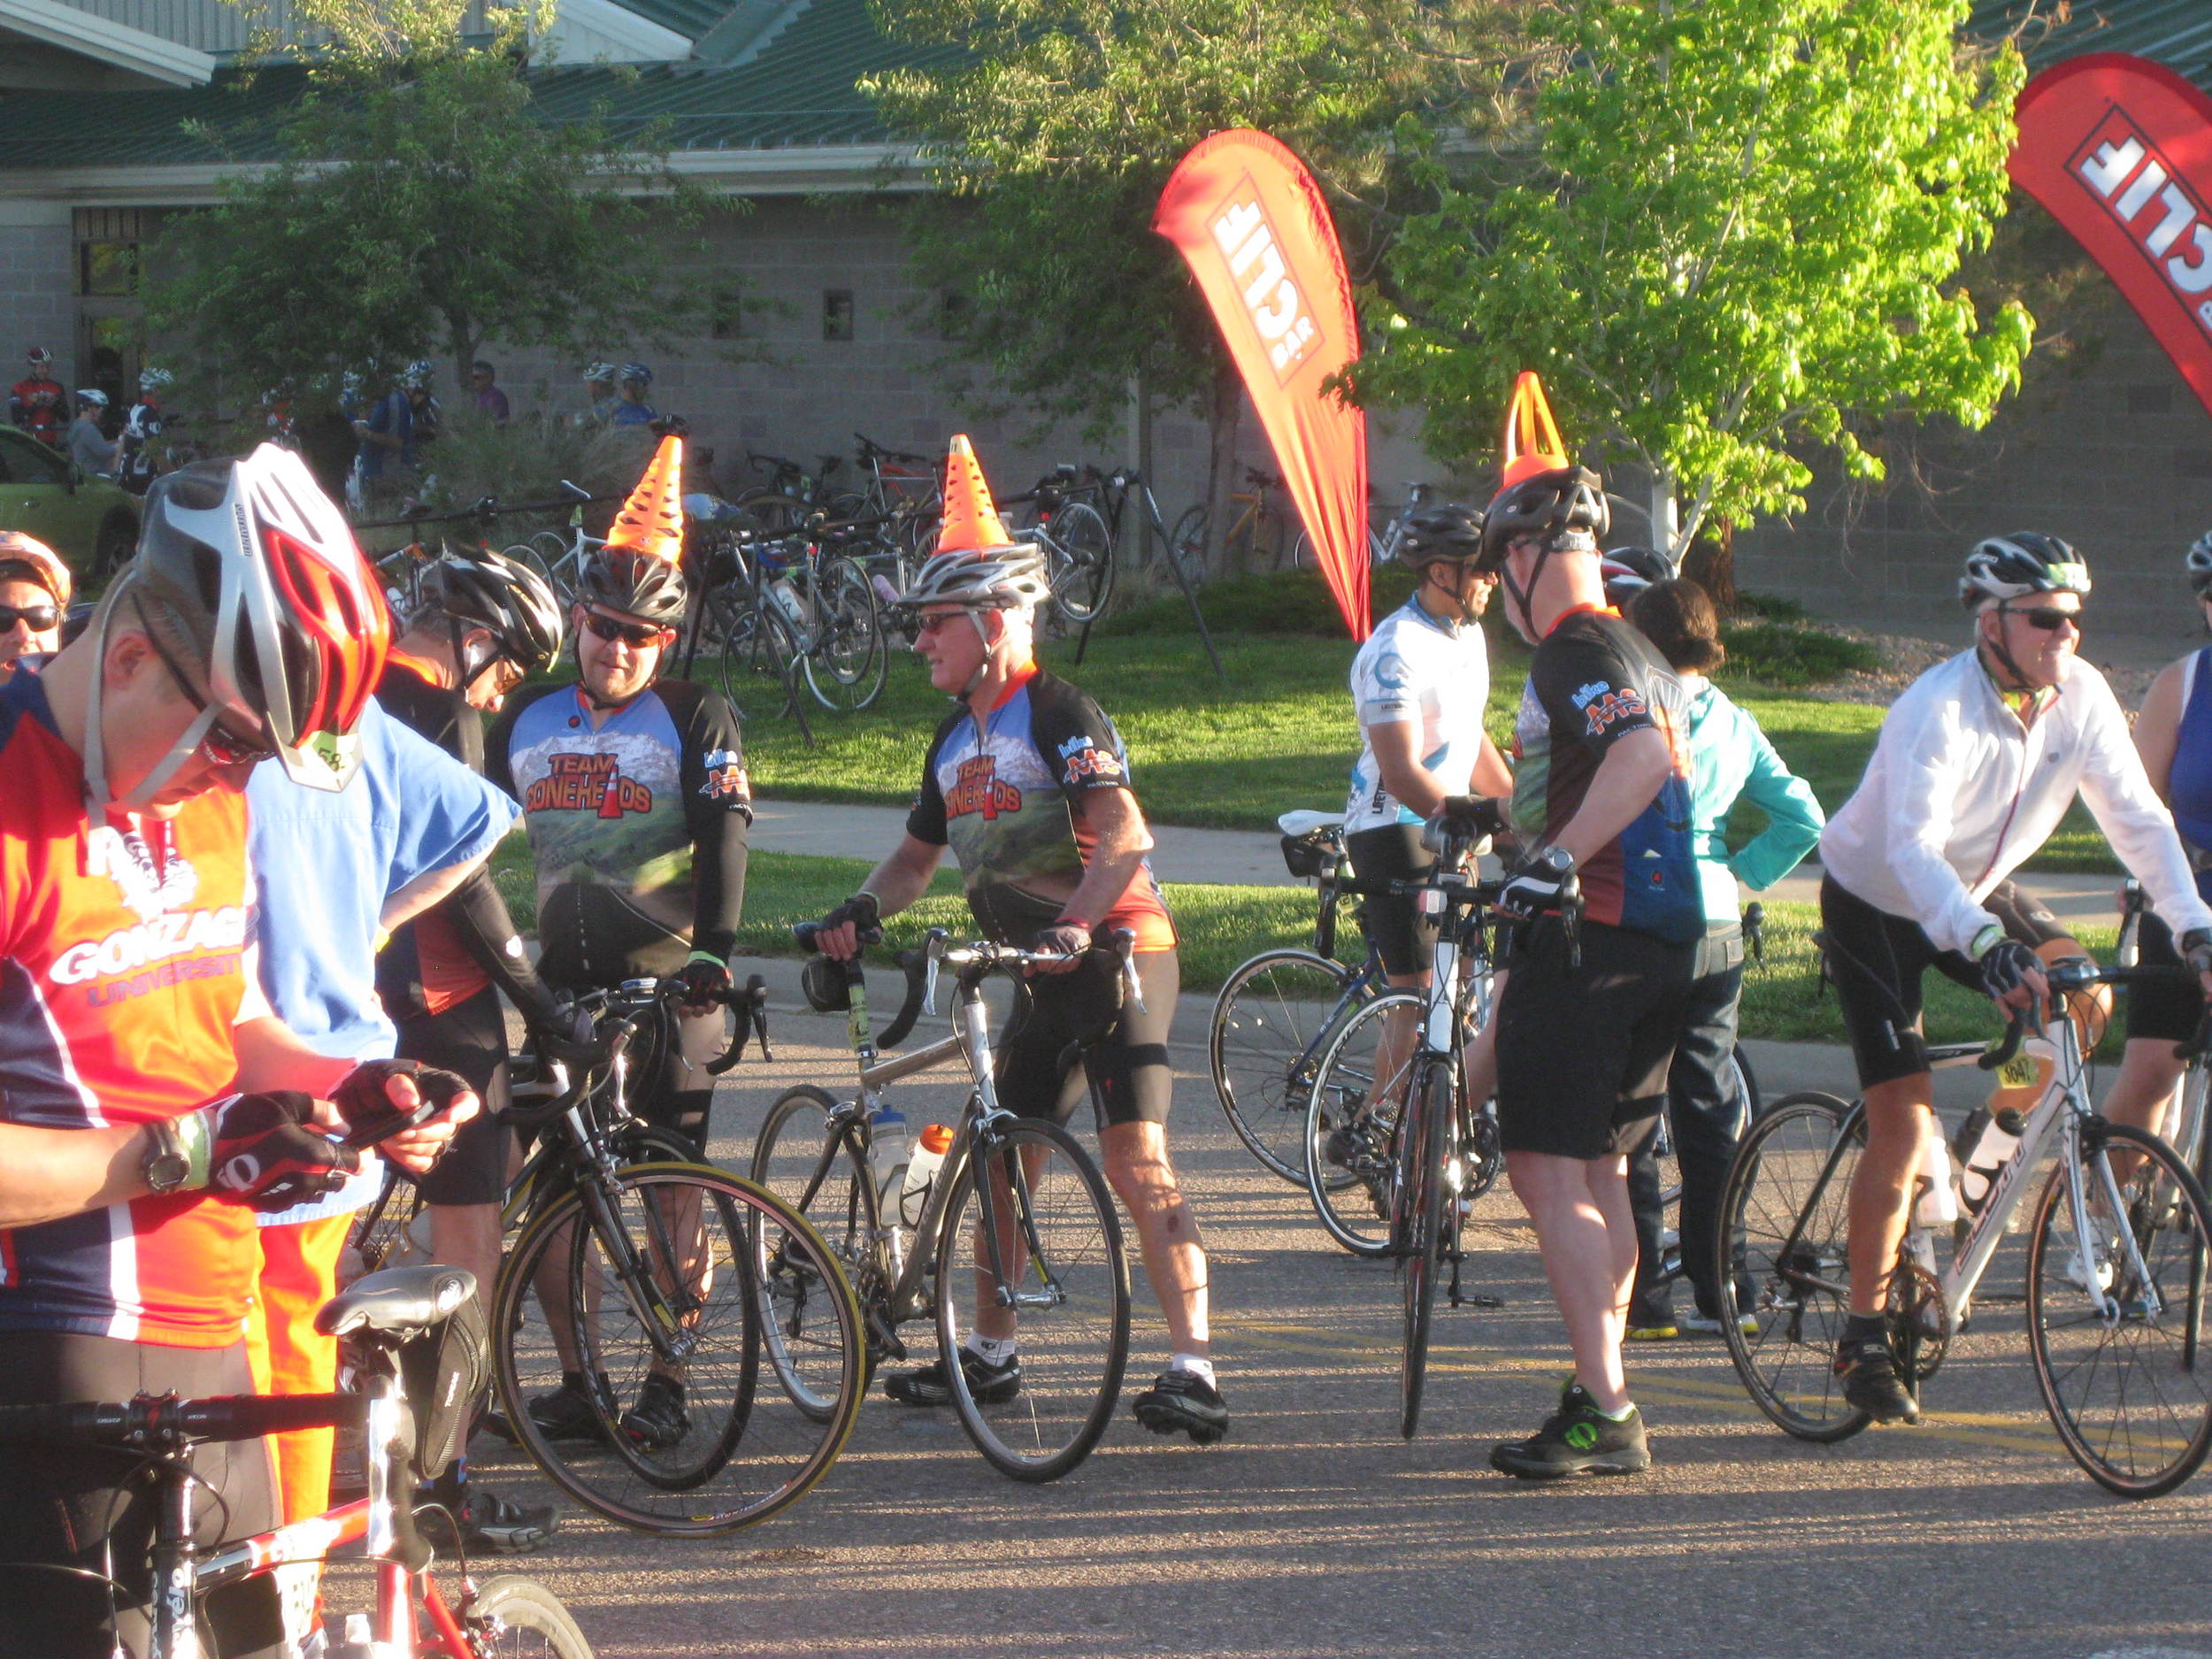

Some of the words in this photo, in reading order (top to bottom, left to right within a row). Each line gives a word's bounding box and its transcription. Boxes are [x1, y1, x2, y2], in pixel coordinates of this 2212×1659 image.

[2080, 134, 2212, 294] CLIF
[1213, 200, 1299, 340] CLIF
[1571, 680, 1610, 710] bike
[549, 752, 618, 775] TEAM
[956, 754, 996, 784] TEAM
[49, 904, 247, 985] GONZAG
[88, 951, 242, 1007] UNIVERSIT
